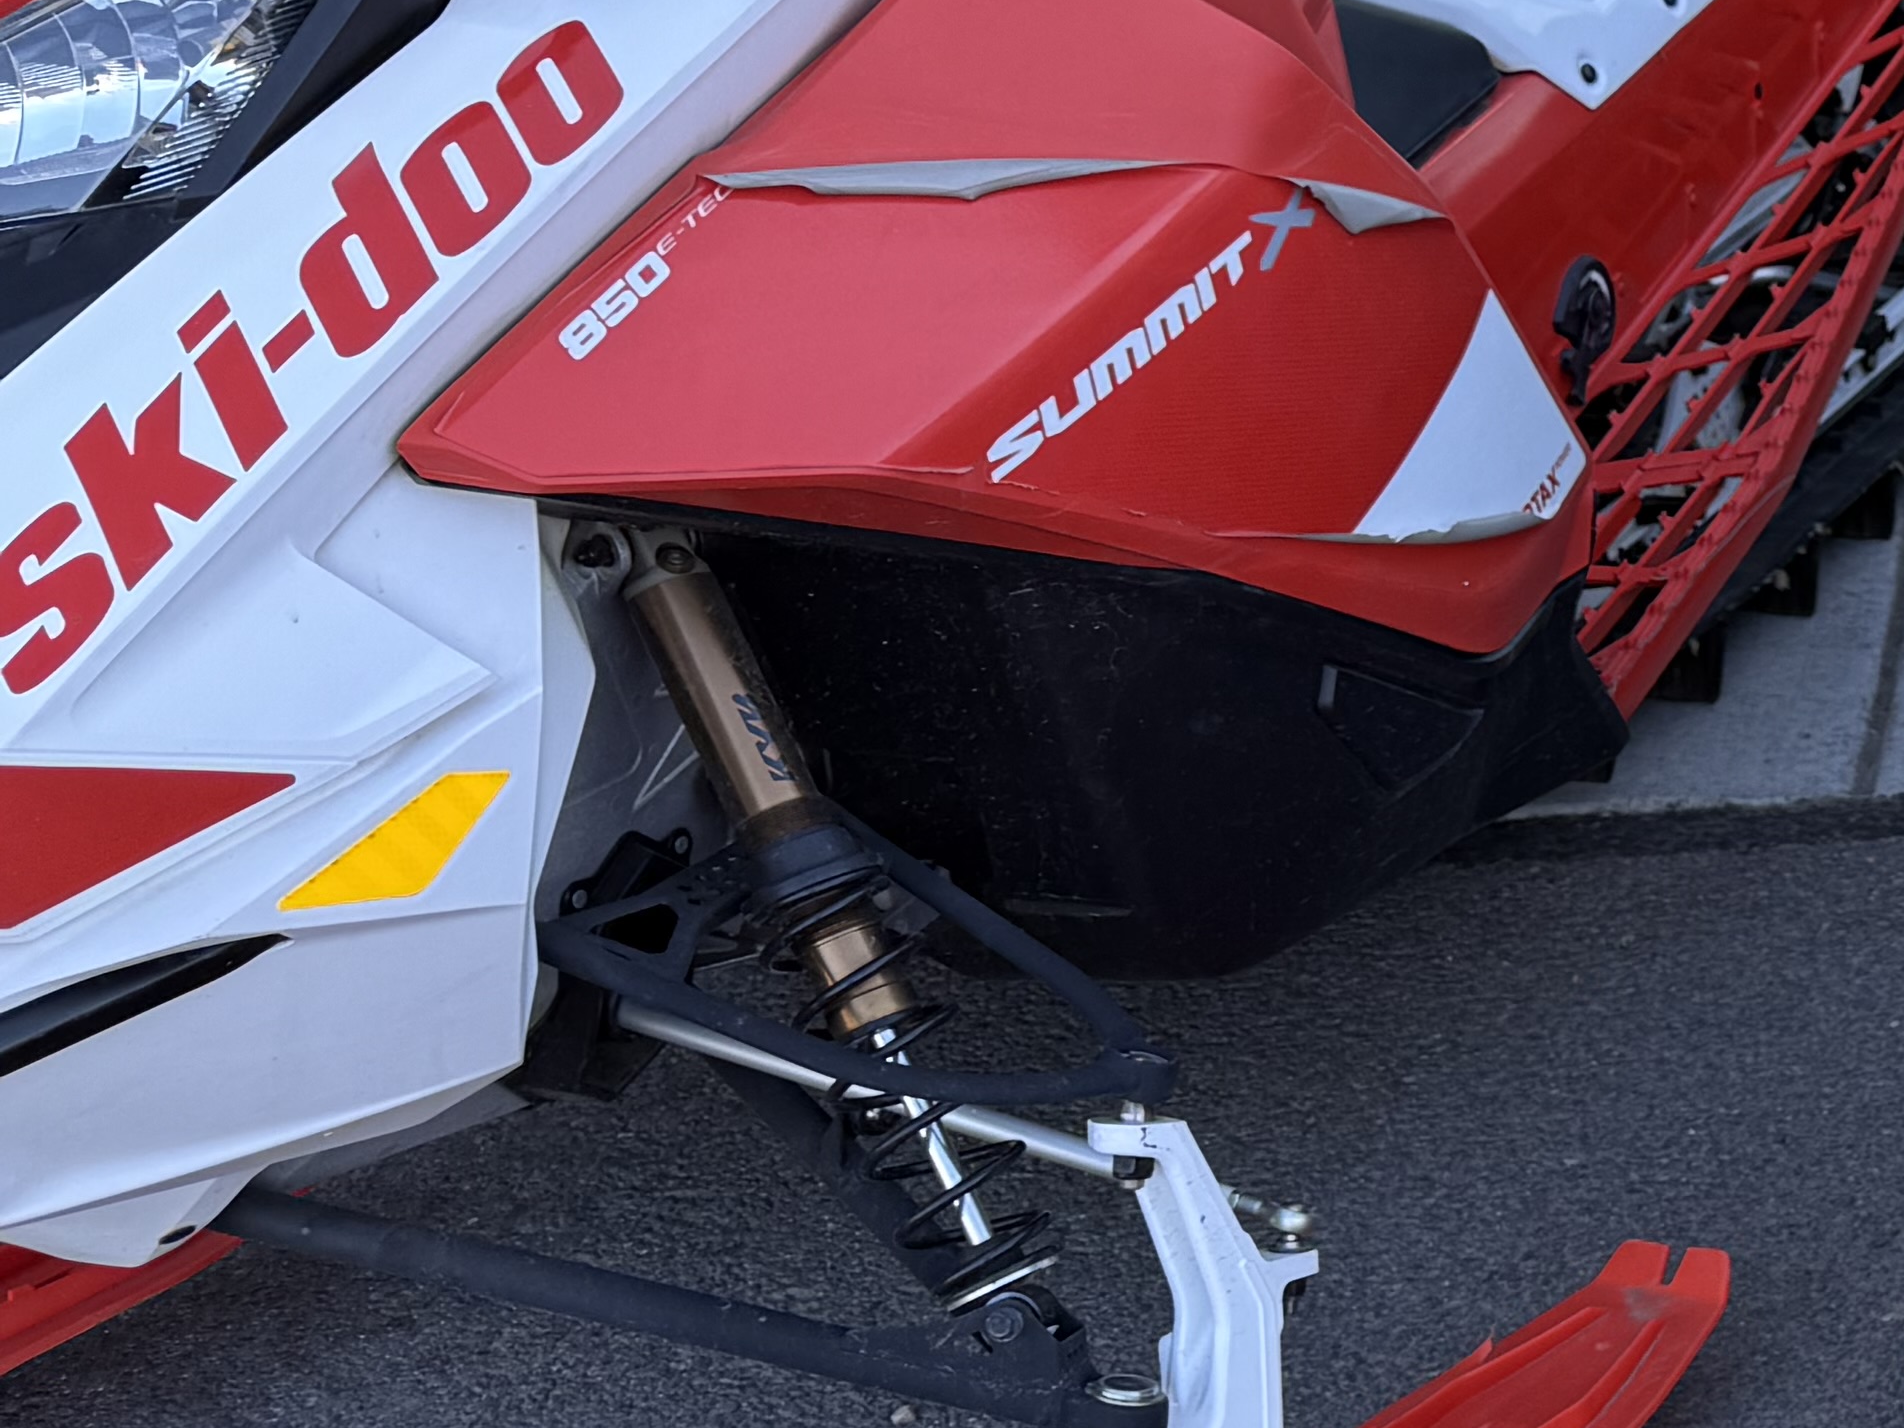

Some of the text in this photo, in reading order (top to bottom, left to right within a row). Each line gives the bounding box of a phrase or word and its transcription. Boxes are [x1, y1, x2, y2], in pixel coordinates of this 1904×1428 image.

[0, 19, 625, 695] ski-doo
[558, 251, 671, 360] 850
[986, 186, 1316, 484] SUMMIT X
